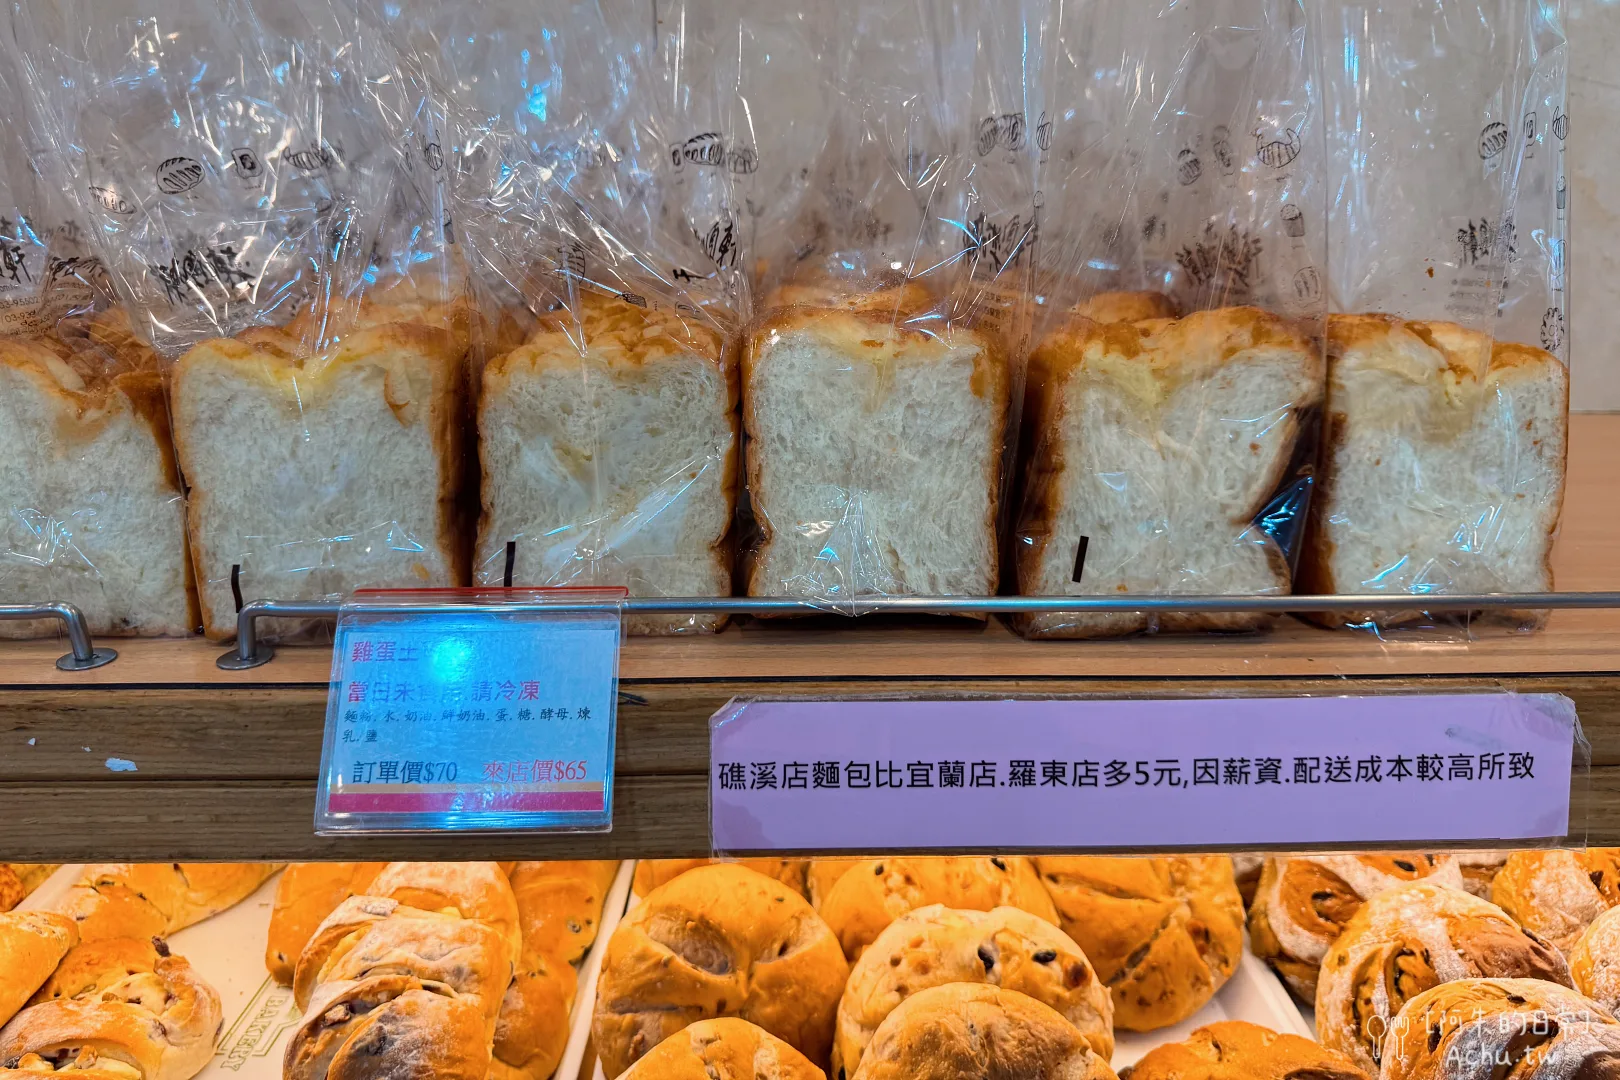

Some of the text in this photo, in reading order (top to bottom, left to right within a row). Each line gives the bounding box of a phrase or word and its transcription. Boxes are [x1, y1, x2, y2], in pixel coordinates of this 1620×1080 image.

[352, 759, 588, 784] 訂單價$70 來店價$65
[220, 996, 289, 1072] BAKERY
